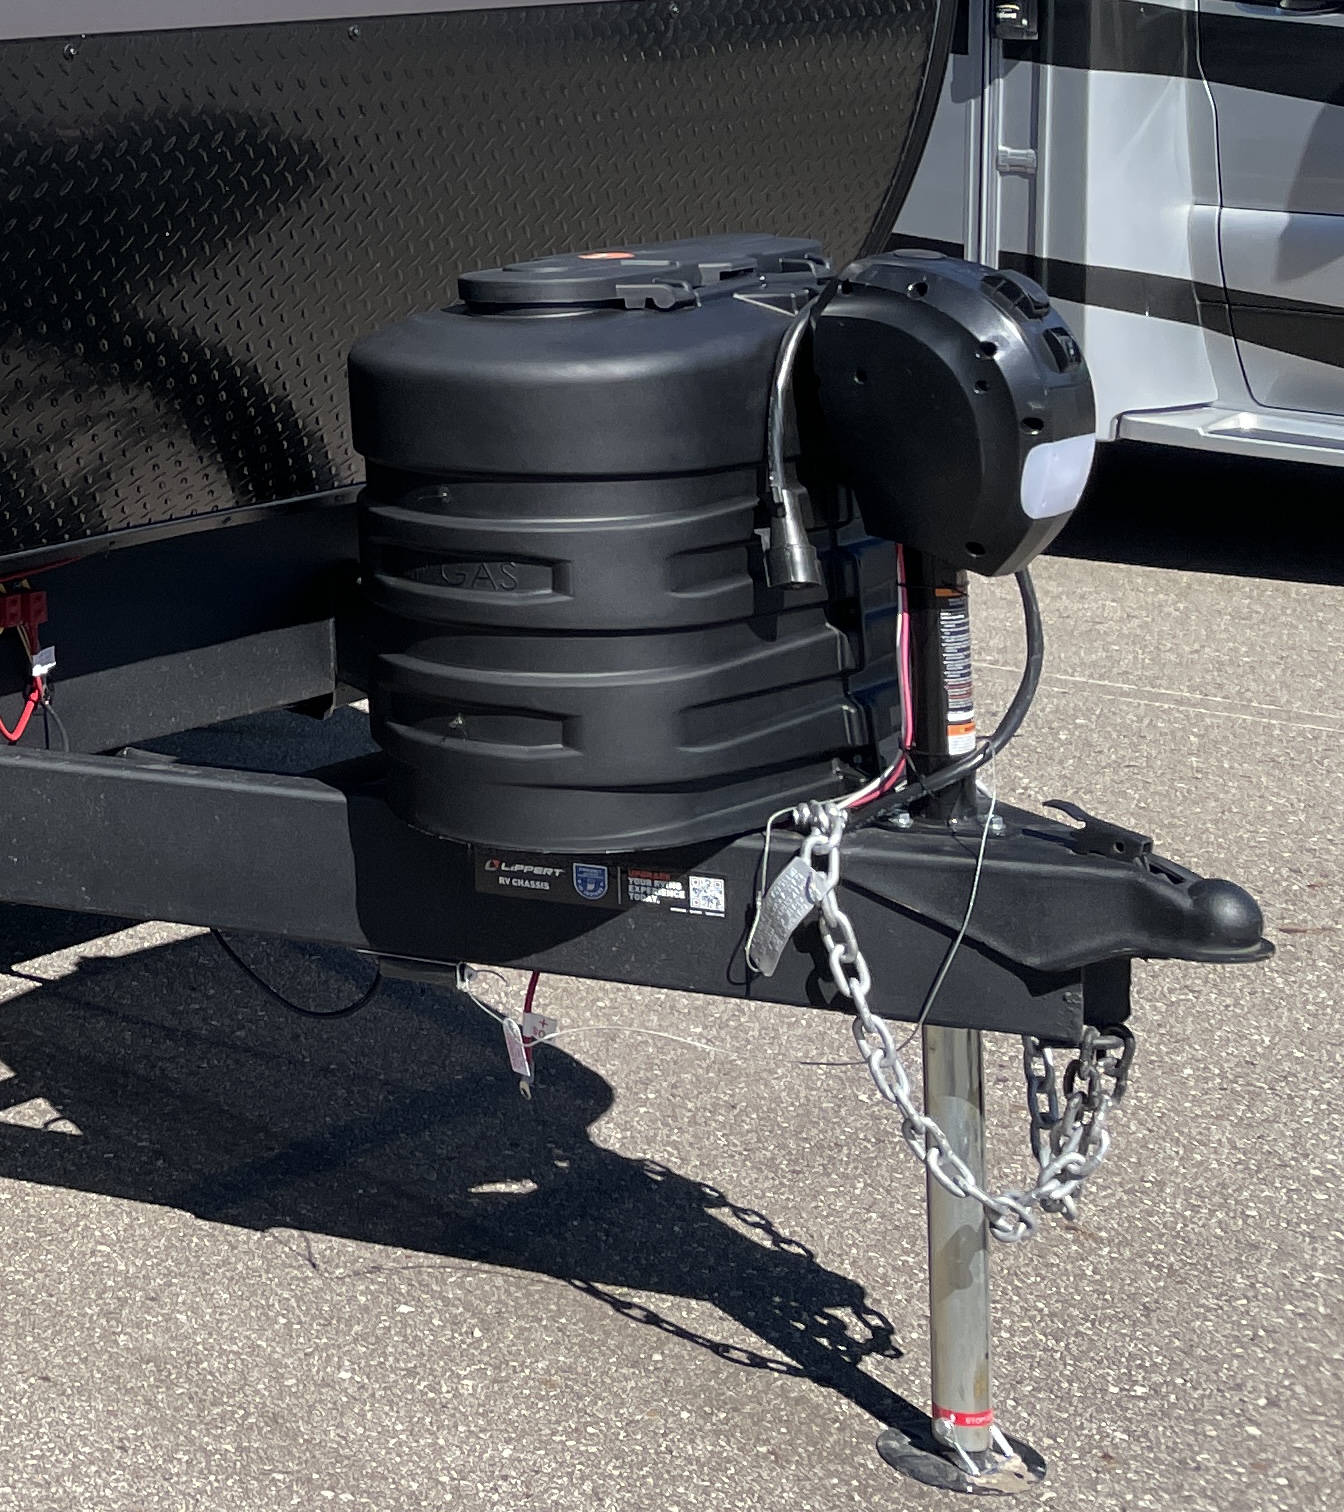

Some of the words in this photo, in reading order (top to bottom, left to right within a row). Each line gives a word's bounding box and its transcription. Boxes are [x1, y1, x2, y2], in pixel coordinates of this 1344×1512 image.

[441, 562, 519, 590] GAS
[498, 876, 511, 885] RV
[512, 878, 550, 890] CHASSIS
[628, 877, 652, 886] YOUR
